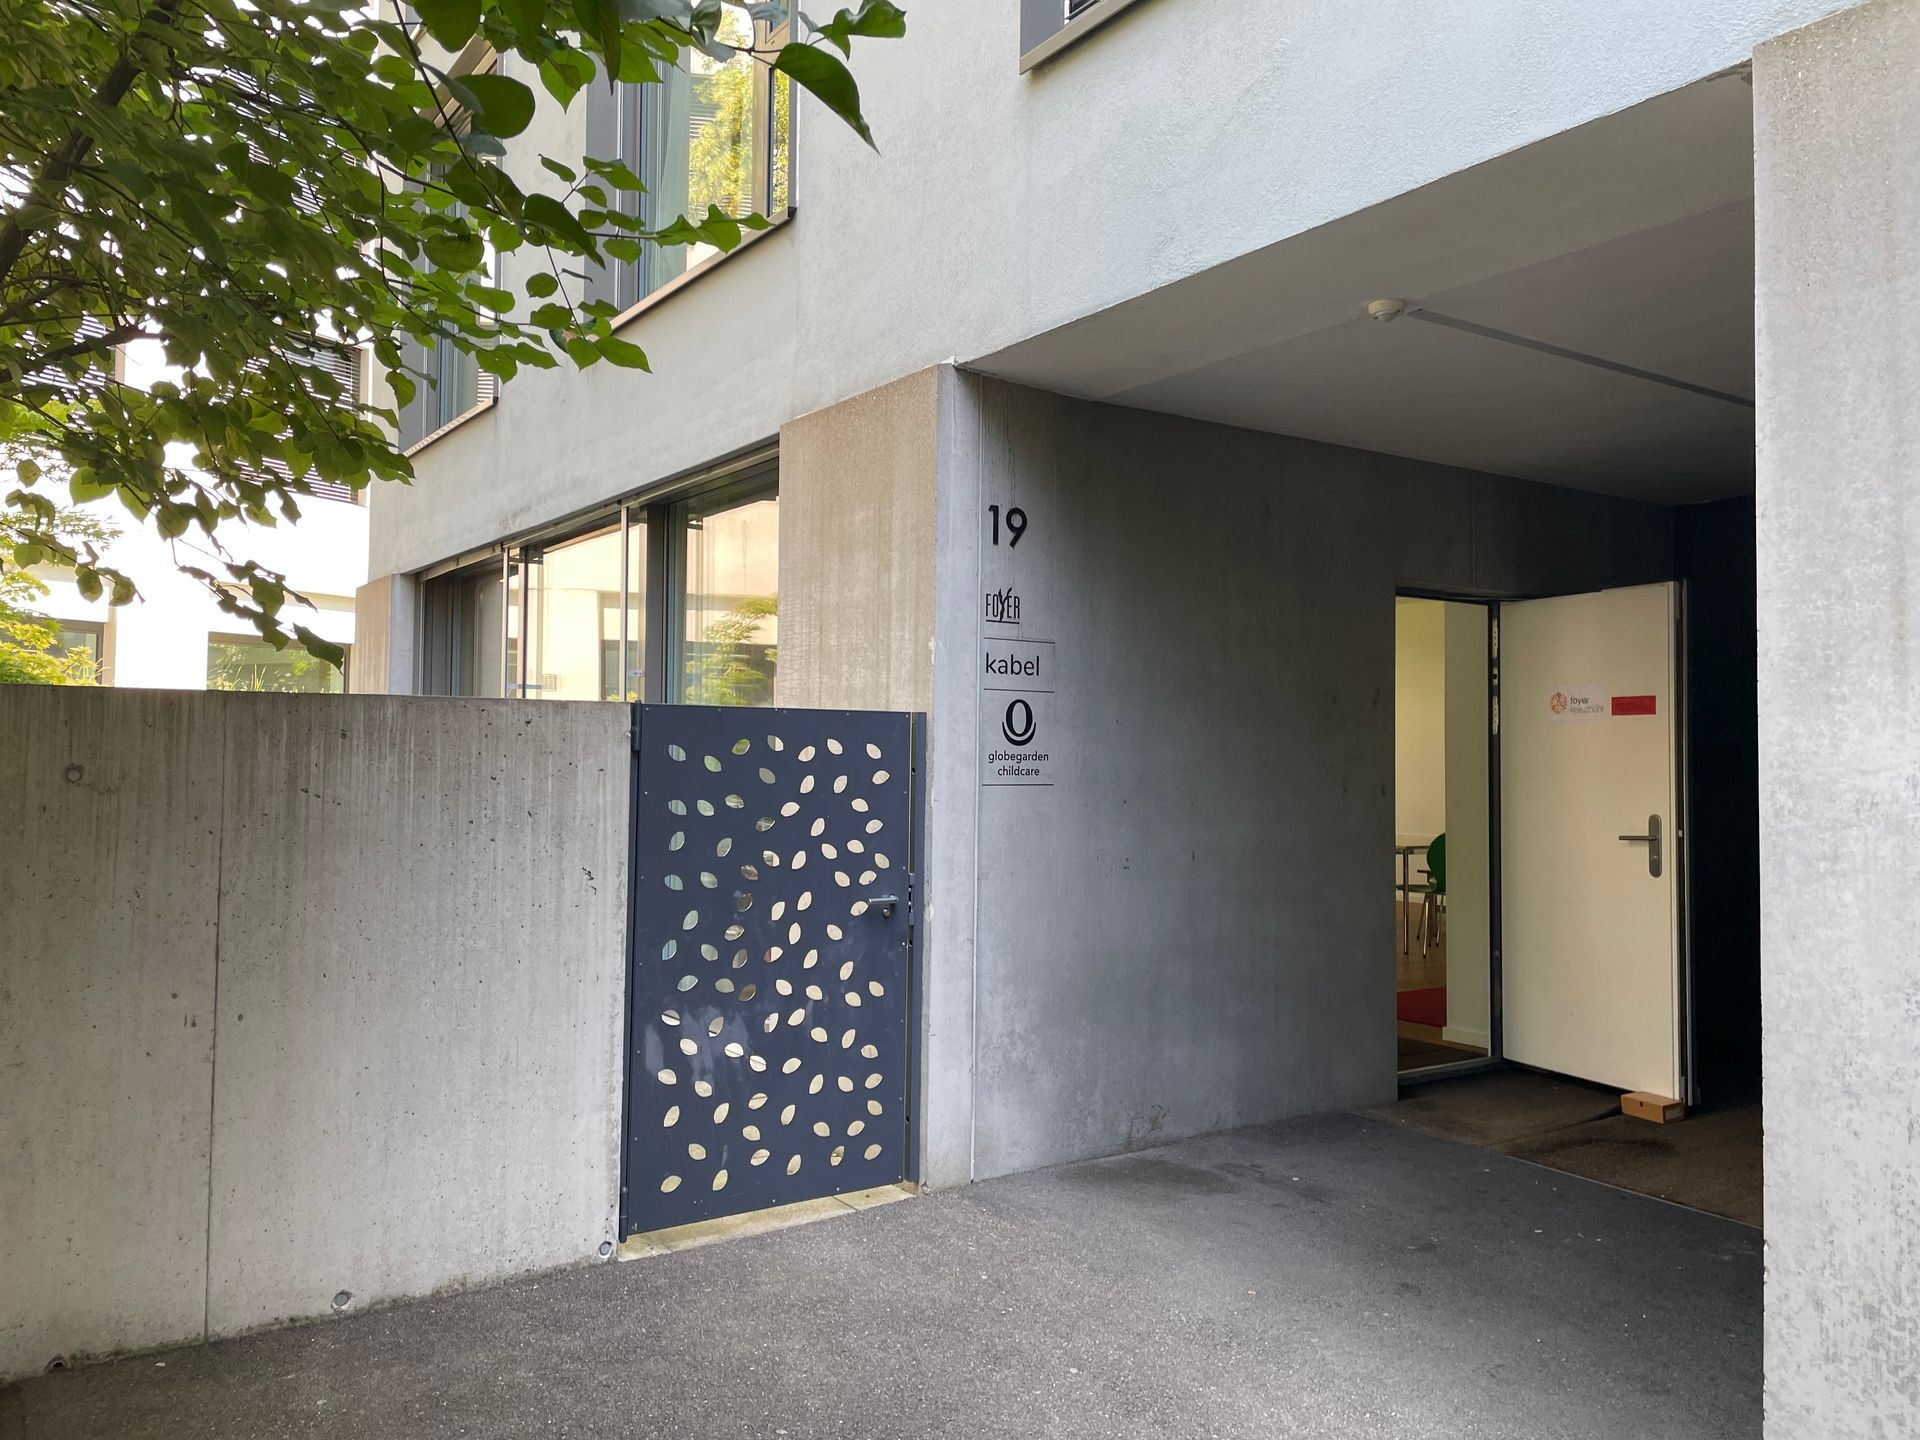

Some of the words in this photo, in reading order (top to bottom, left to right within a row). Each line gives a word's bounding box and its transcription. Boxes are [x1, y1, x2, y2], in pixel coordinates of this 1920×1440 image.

[988, 504, 1028, 548] 19
[986, 588, 1020, 622] FOYER
[986, 652, 1040, 676] kabel
[1570, 696, 1589, 705] foyer
[988, 751, 1049, 763] globegarden
[997, 765, 1040, 776] childcare
